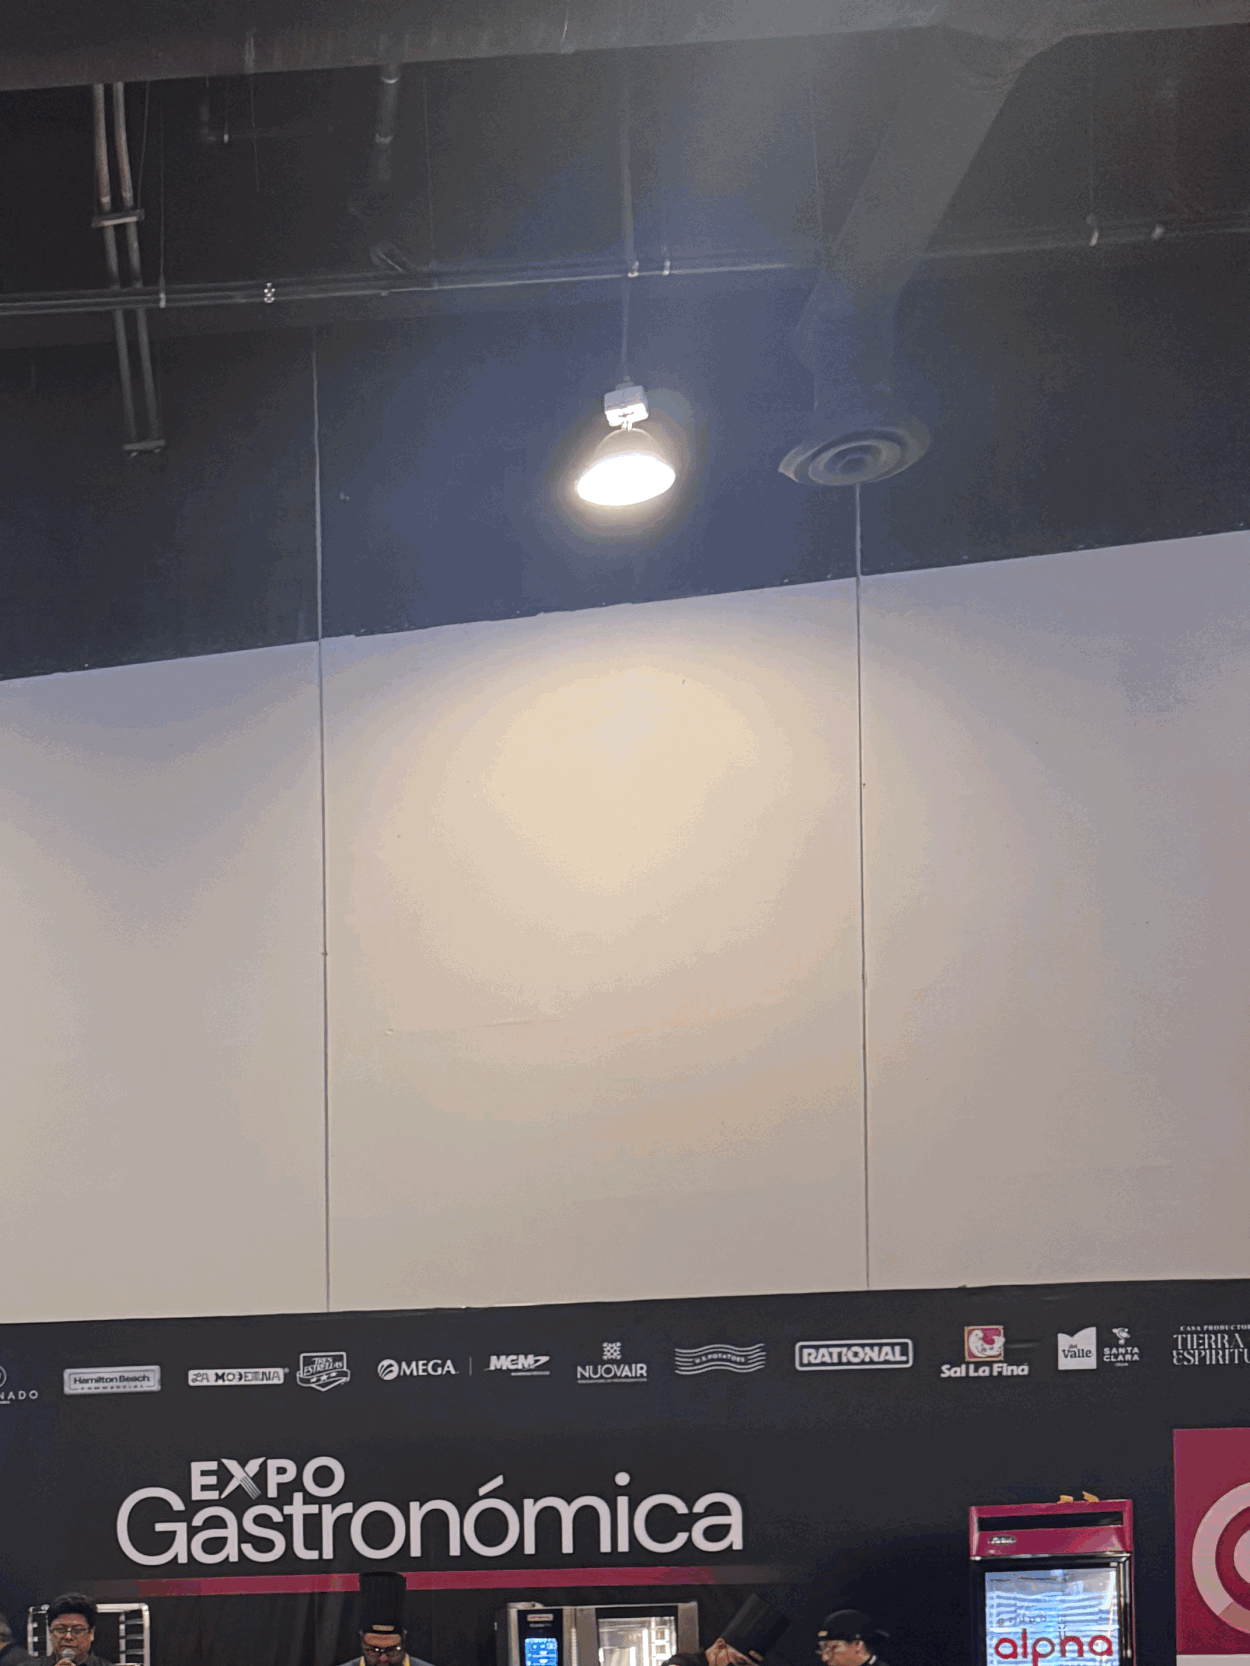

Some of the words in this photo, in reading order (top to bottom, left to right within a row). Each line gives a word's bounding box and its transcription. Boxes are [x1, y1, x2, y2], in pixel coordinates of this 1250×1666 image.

[1173, 1333, 1244, 1349] TIERRA
[802, 1345, 907, 1364] RATIONAL
[1061, 1347, 1092, 1359] Valle
[1103, 1354, 1139, 1362] CLARA
[400, 1359, 456, 1376] MEGA
[576, 1363, 647, 1379] NUOVAIR
[940, 1363, 966, 1378] Sal
[968, 1363, 991, 1377] La
[992, 1363, 1029, 1377] Fina
[73, 1376, 118, 1385] Hamilton
[118, 1374, 150, 1383] Beach
[191, 1372, 210, 1384] LA
[214, 1371, 281, 1383] MODERNA
[190, 1456, 345, 1500] EXPO
[116, 1473, 744, 1565] Gastronómica
